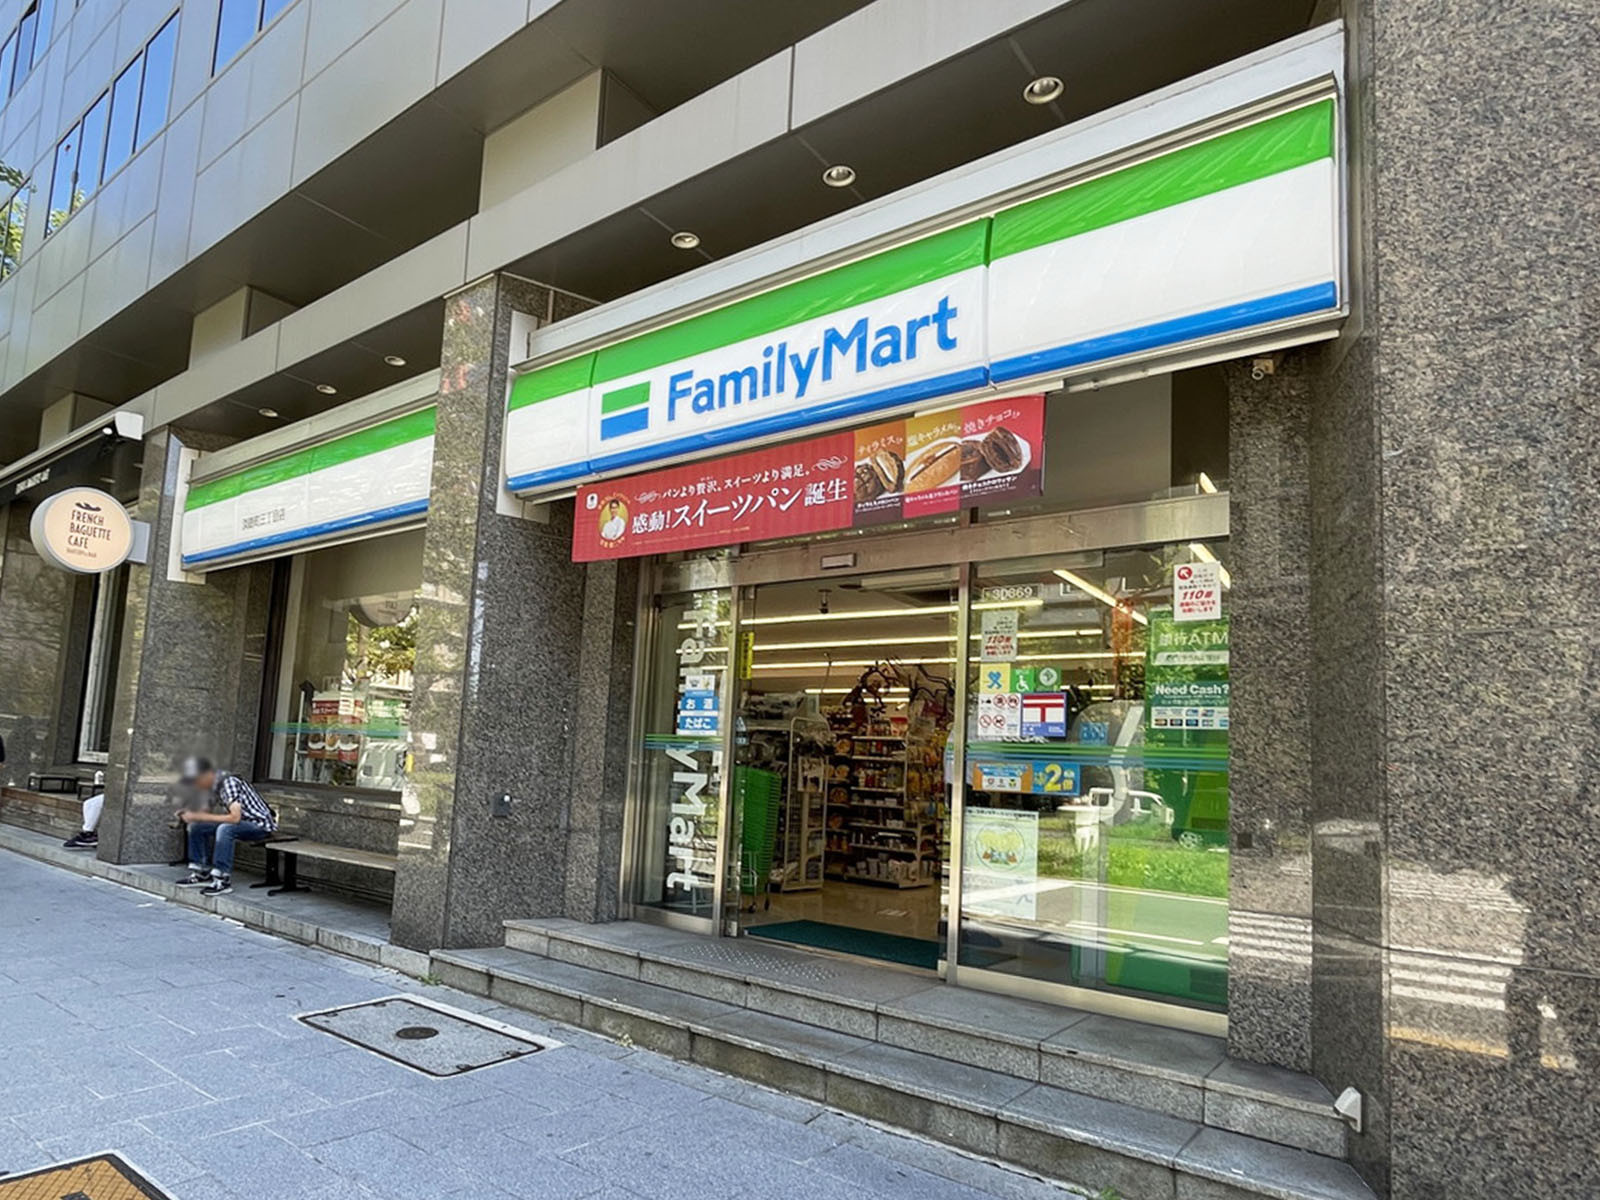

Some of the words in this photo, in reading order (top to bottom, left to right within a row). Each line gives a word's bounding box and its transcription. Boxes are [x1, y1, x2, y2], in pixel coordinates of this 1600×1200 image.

[667, 295, 958, 422] FamilyMart
[71, 510, 105, 526] FRENCH
[69, 523, 111, 541] BAGUETTE
[68, 535, 89, 549] CAFE
[1155, 684, 1187, 695] Need
[1189, 684, 1230, 695] Cash?
[685, 717, 712, 729] たばこ
